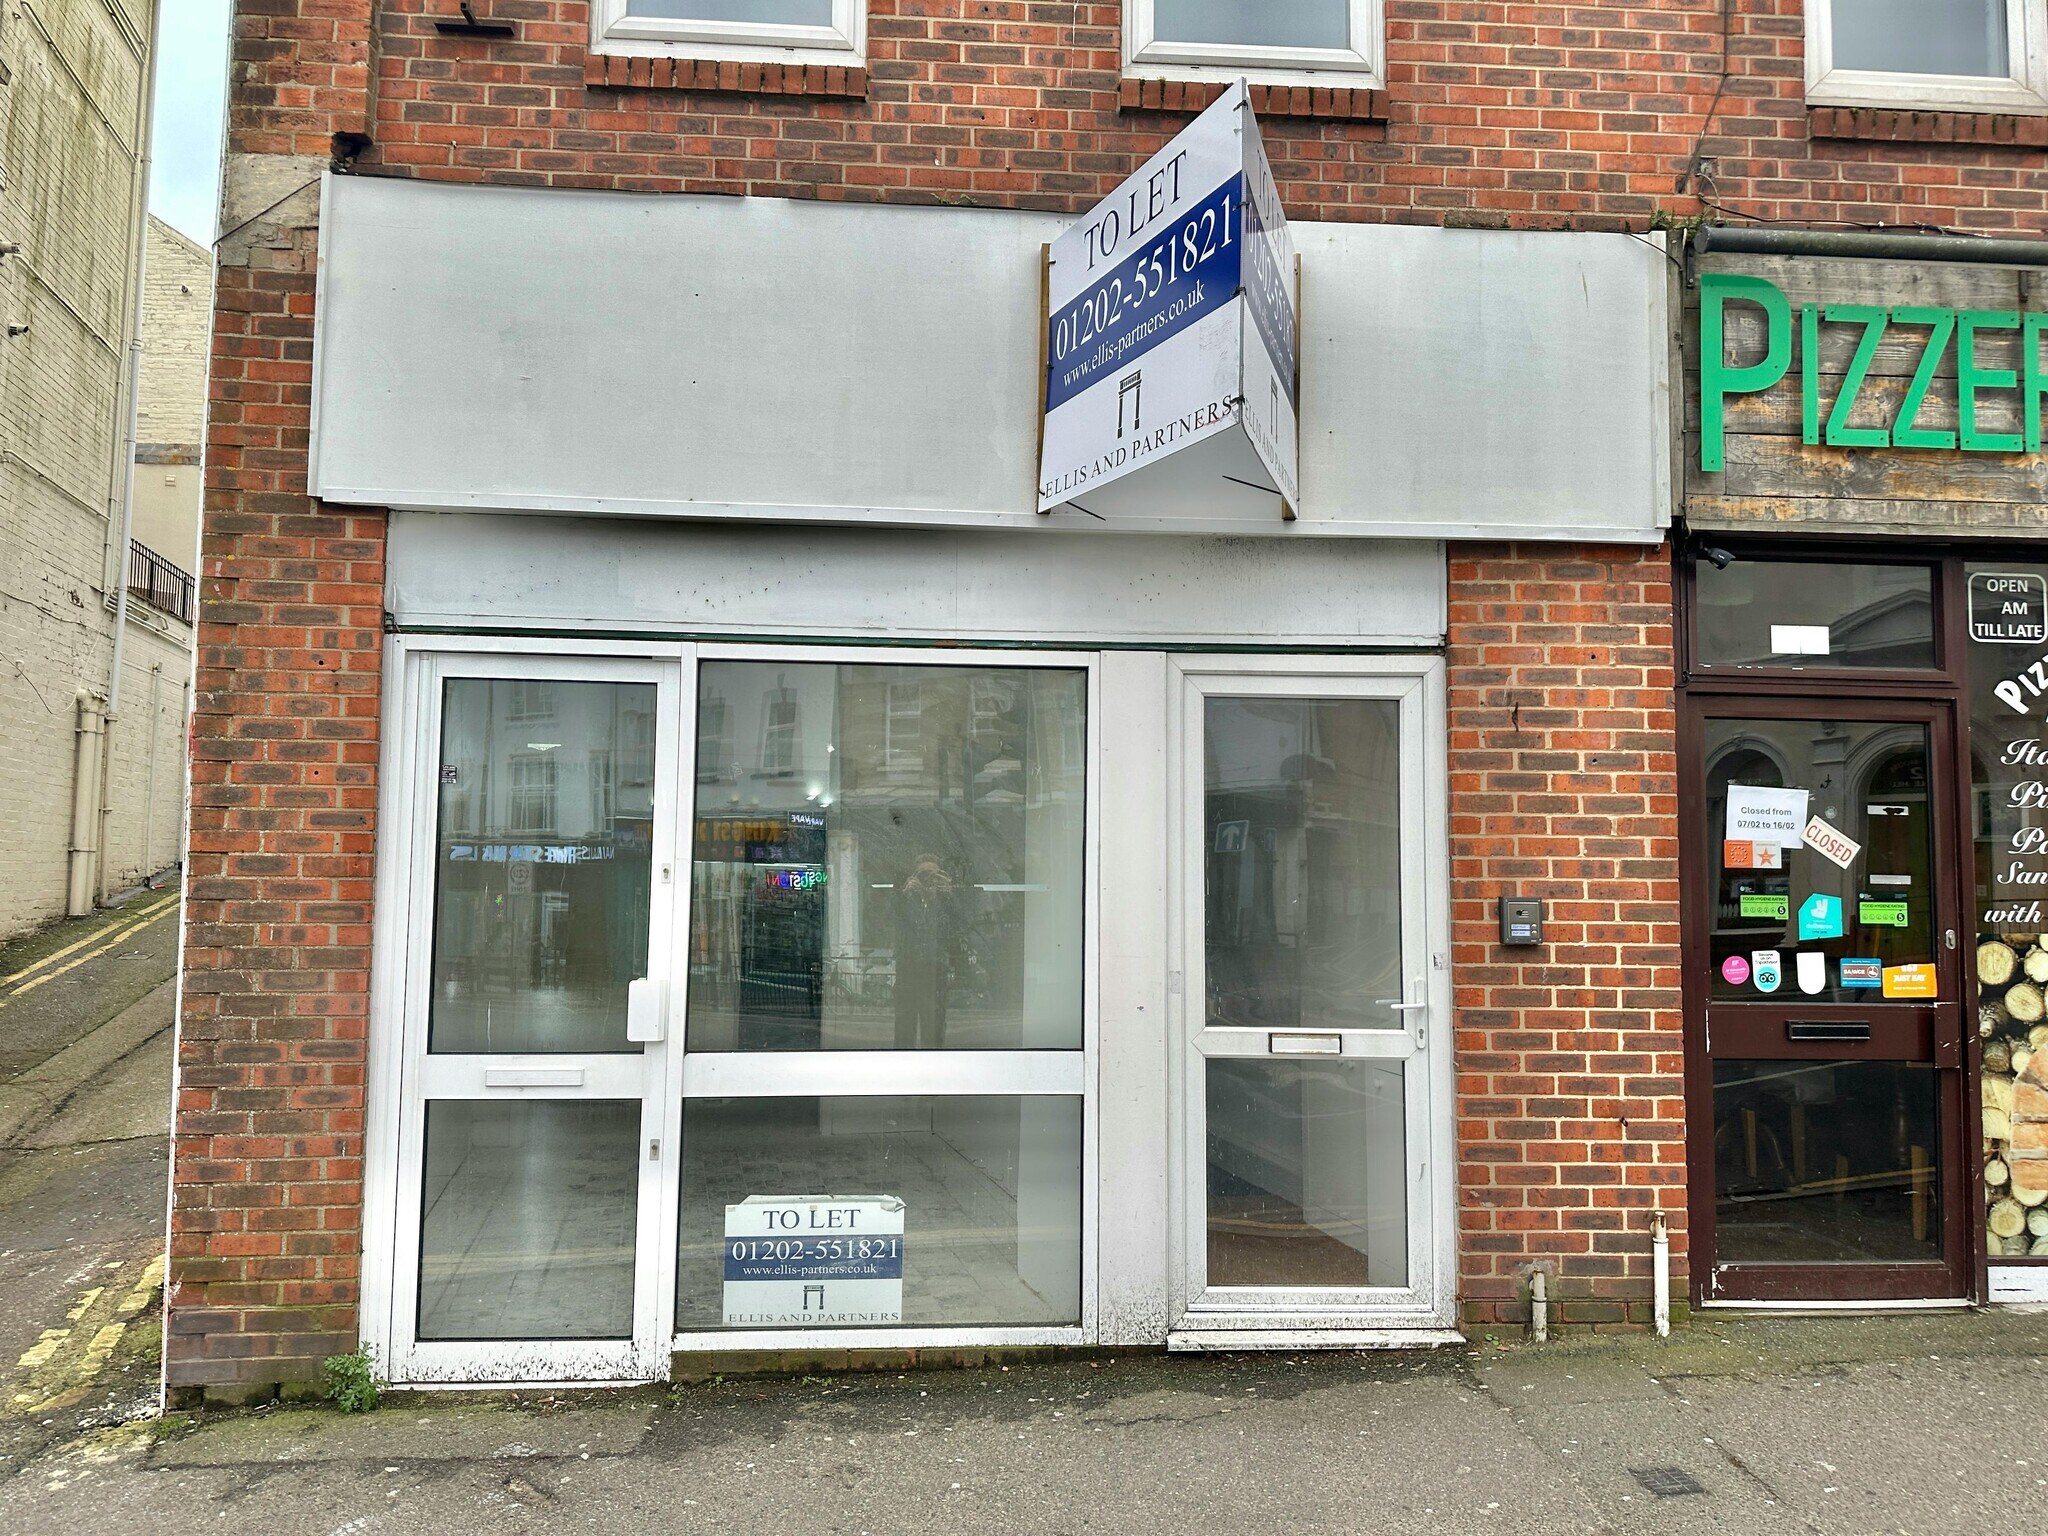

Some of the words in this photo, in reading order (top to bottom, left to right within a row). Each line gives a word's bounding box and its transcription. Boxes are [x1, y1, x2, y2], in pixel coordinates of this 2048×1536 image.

[1257, 149, 1270, 220] TO
[1084, 218, 1120, 271] TO
[1127, 149, 1187, 237] LET
[1056, 194, 1234, 361] 01202-551821
[1248, 202, 1295, 362] 01202-55182
[1062, 279, 1205, 389] www.ellis-partners.co.uk
[1045, 466, 1087, 499] ELLIS
[1090, 448, 1127, 477] AND
[1131, 394, 1234, 459] PARTNERS
[1987, 578, 2029, 592] OPEN
[2001, 601, 2028, 615] AM
[1974, 623, 2005, 637] TILL
[2008, 624, 2043, 638] LATE
[1741, 806, 1771, 815] Closed
[1772, 807, 1792, 816] from
[1737, 820, 1761, 829] 07/02
[1762, 821, 1771, 829] to
[1773, 822, 1795, 830] 16/02
[1806, 825, 1852, 863] CLOSED
[1983, 900, 2044, 924] with
[763, 1210, 800, 1230] TO
[809, 1209, 861, 1229] LET
[732, 1239, 898, 1261] 01202-551821
[743, 1264, 877, 1276] www.ellis-partners.co.uk
[729, 1313, 773, 1323] ELLIS
[778, 1313, 812, 1322] AND
[817, 1312, 899, 1322] PARTNERS
